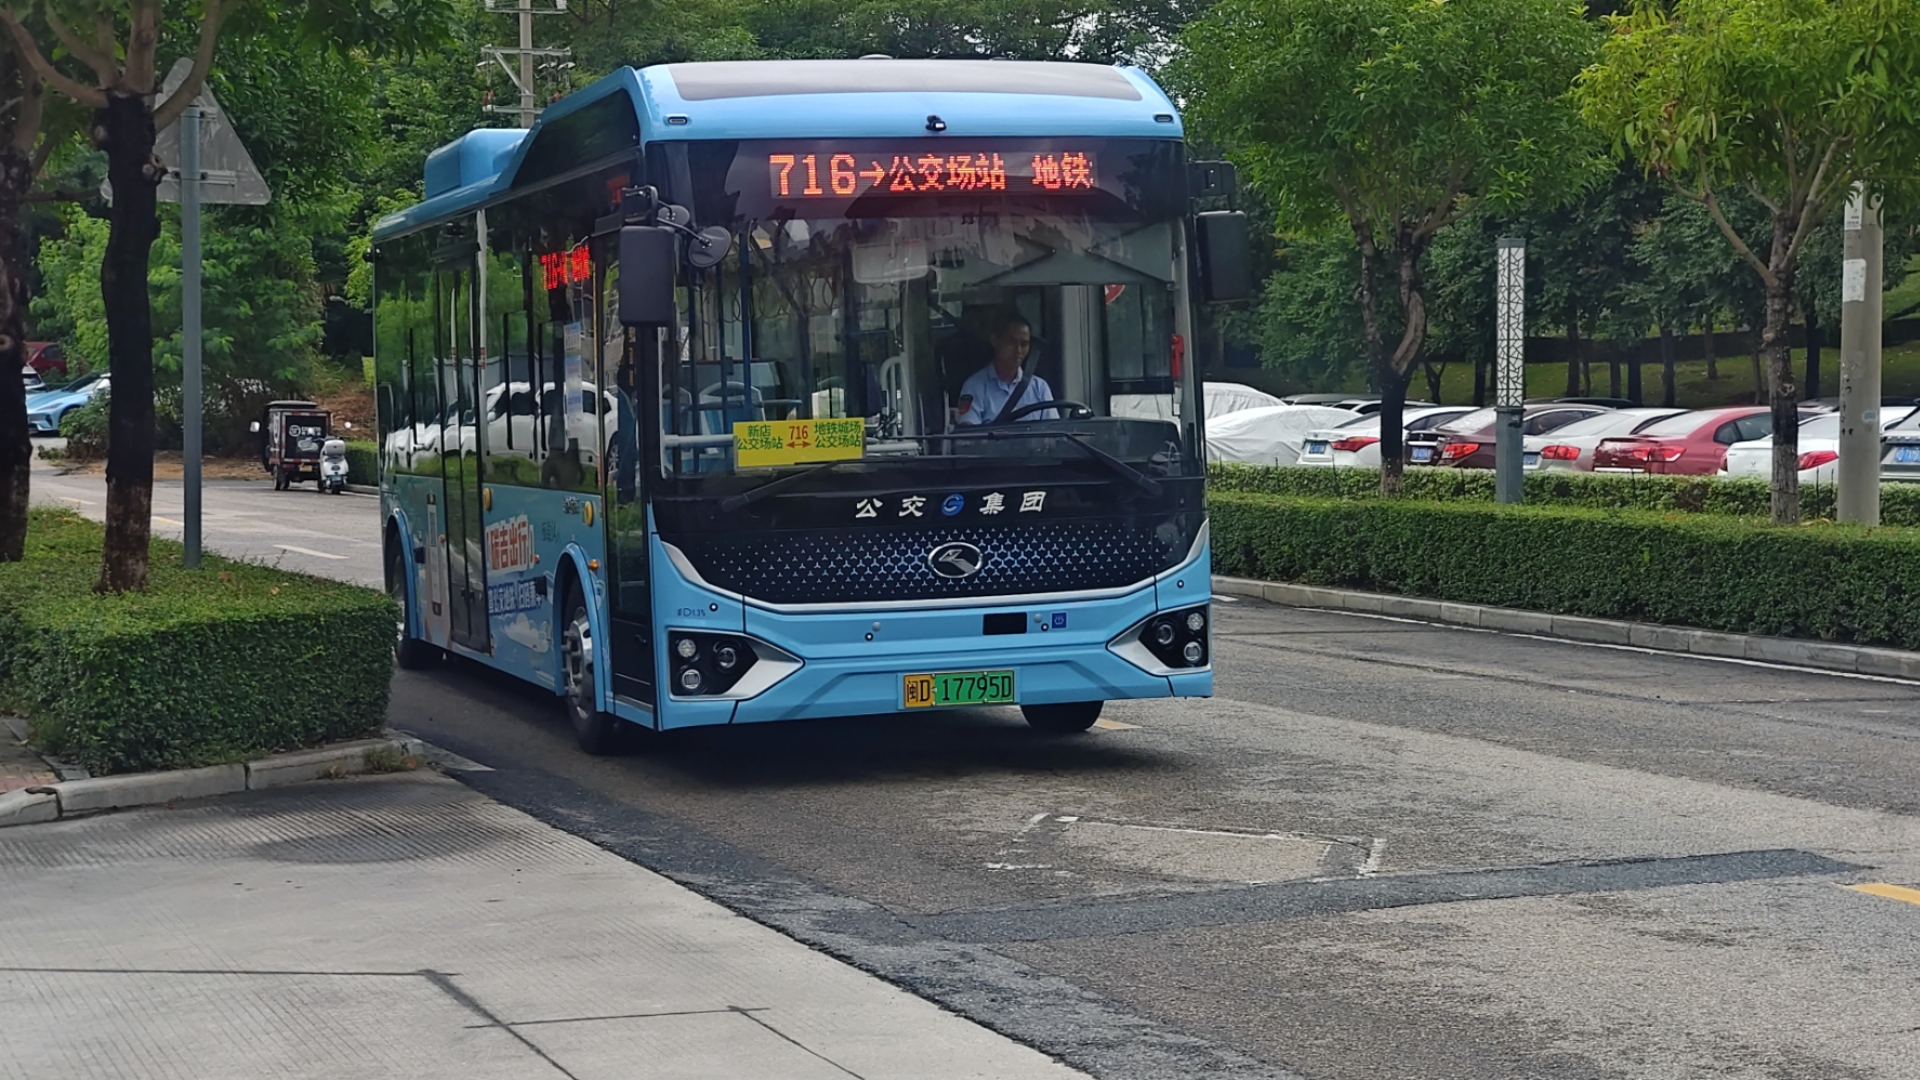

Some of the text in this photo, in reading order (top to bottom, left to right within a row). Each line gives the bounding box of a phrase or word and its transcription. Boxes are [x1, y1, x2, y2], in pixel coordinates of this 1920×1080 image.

[769, 151, 1094, 195] 716 公交场站 地铁
[748, 424, 772, 437] 新店
[788, 425, 809, 440] 716
[737, 434, 861, 450] 公交场站 公交场站
